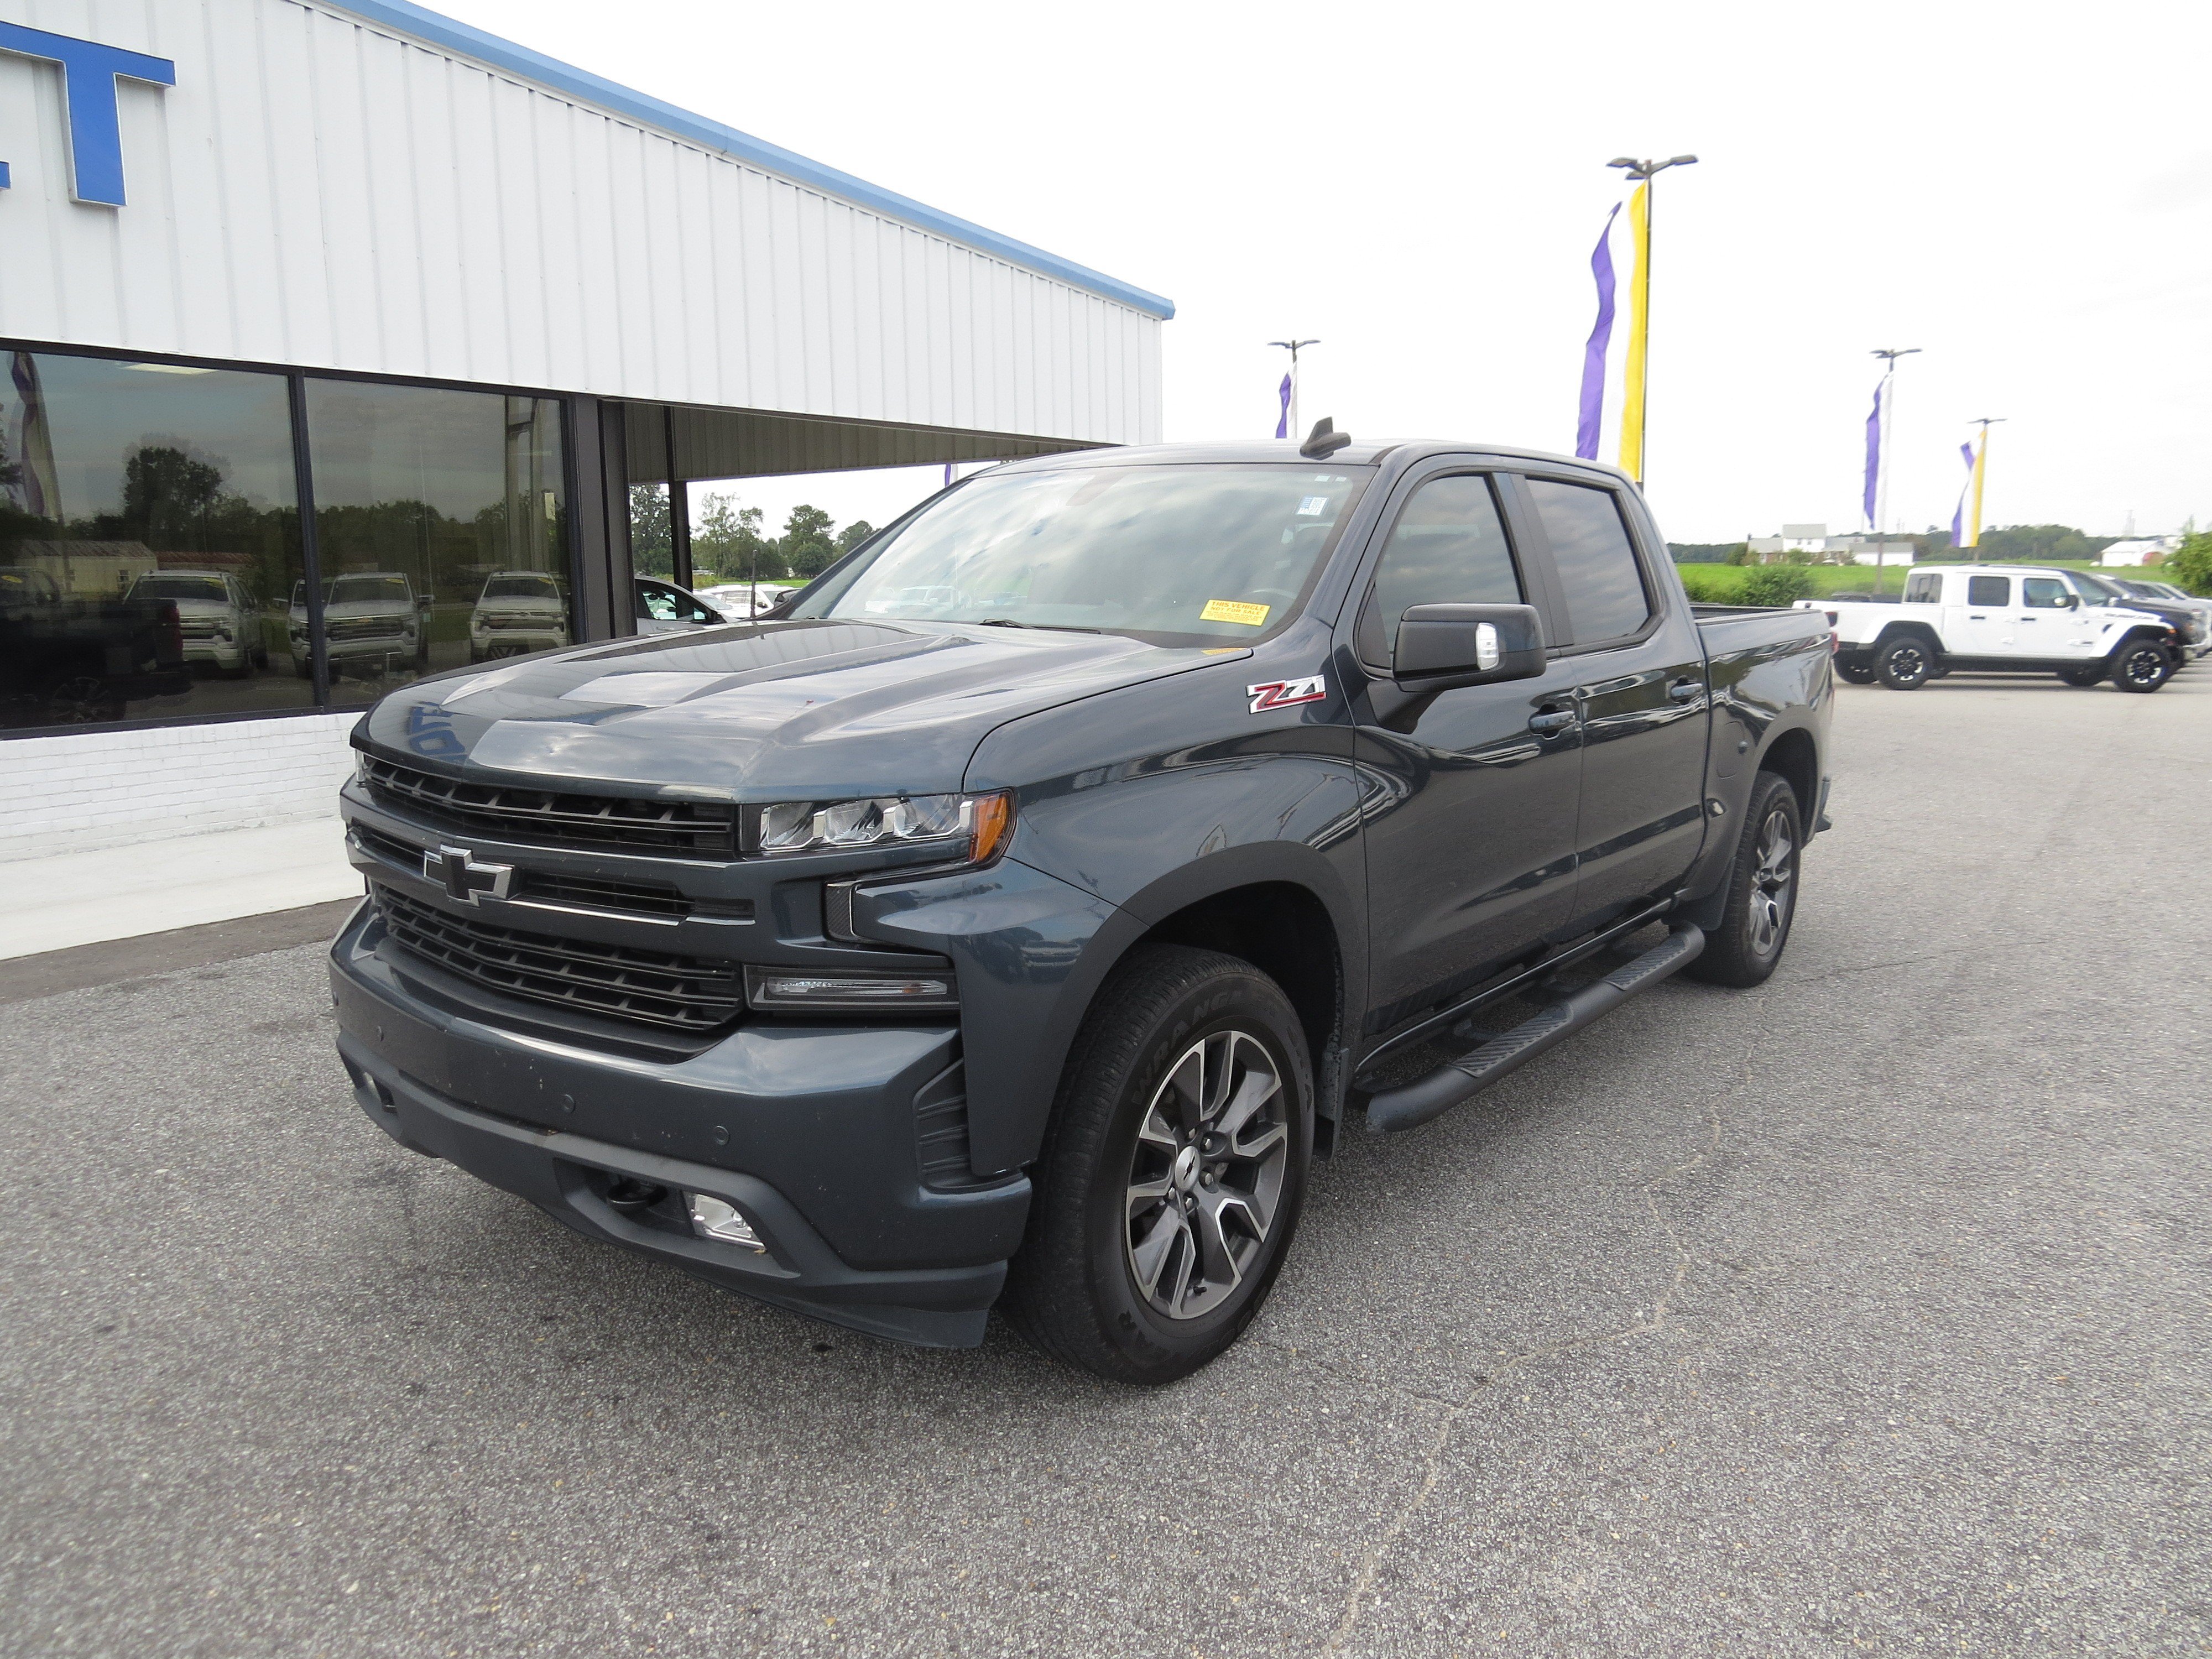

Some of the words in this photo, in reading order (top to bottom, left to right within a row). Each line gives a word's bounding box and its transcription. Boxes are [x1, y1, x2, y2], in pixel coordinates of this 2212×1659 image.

[0, 20, 176, 207] T
[1232, 603, 1265, 611] VEHICLE
[1246, 674, 1327, 714] Z71
